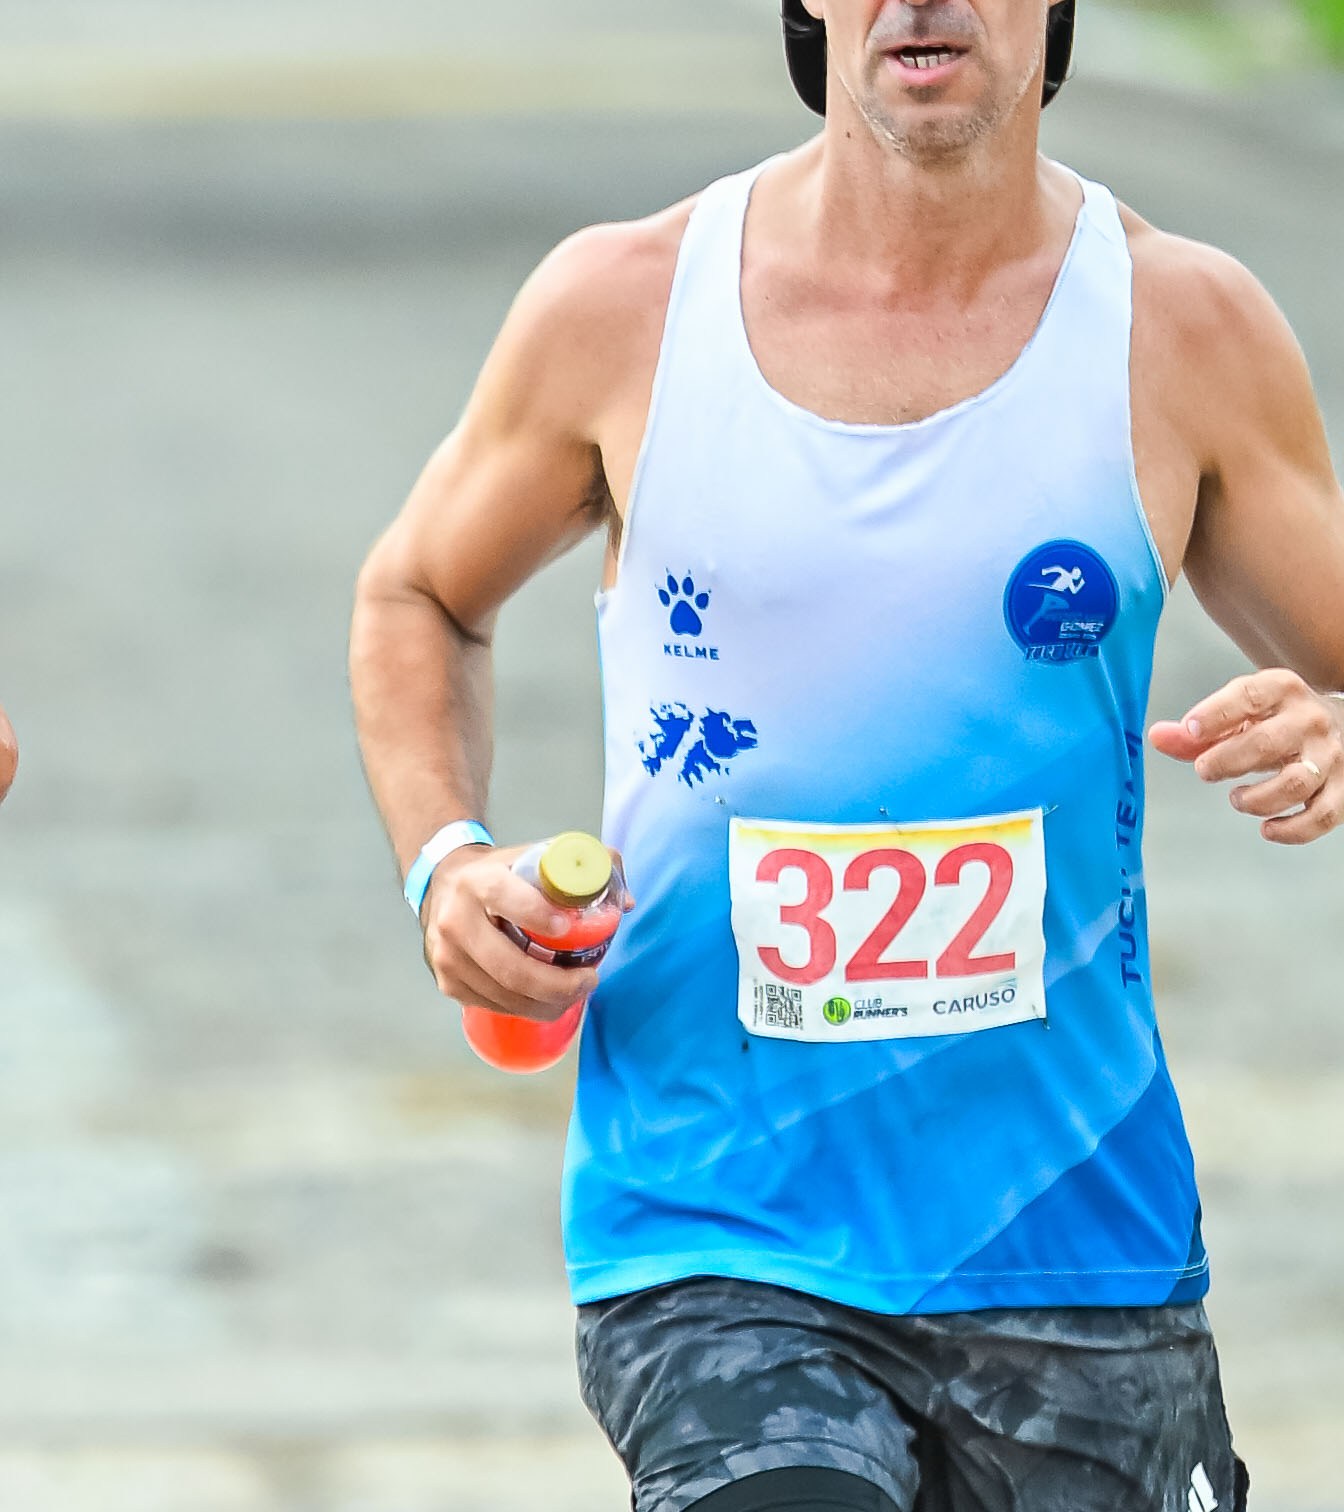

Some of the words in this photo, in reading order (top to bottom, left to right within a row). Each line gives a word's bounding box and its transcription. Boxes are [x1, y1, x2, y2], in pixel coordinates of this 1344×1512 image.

[663, 644, 720, 661] KELME
[755, 842, 1016, 987] 322
[853, 998, 883, 1009] CLUB
[932, 988, 1016, 1015] CARUSO
